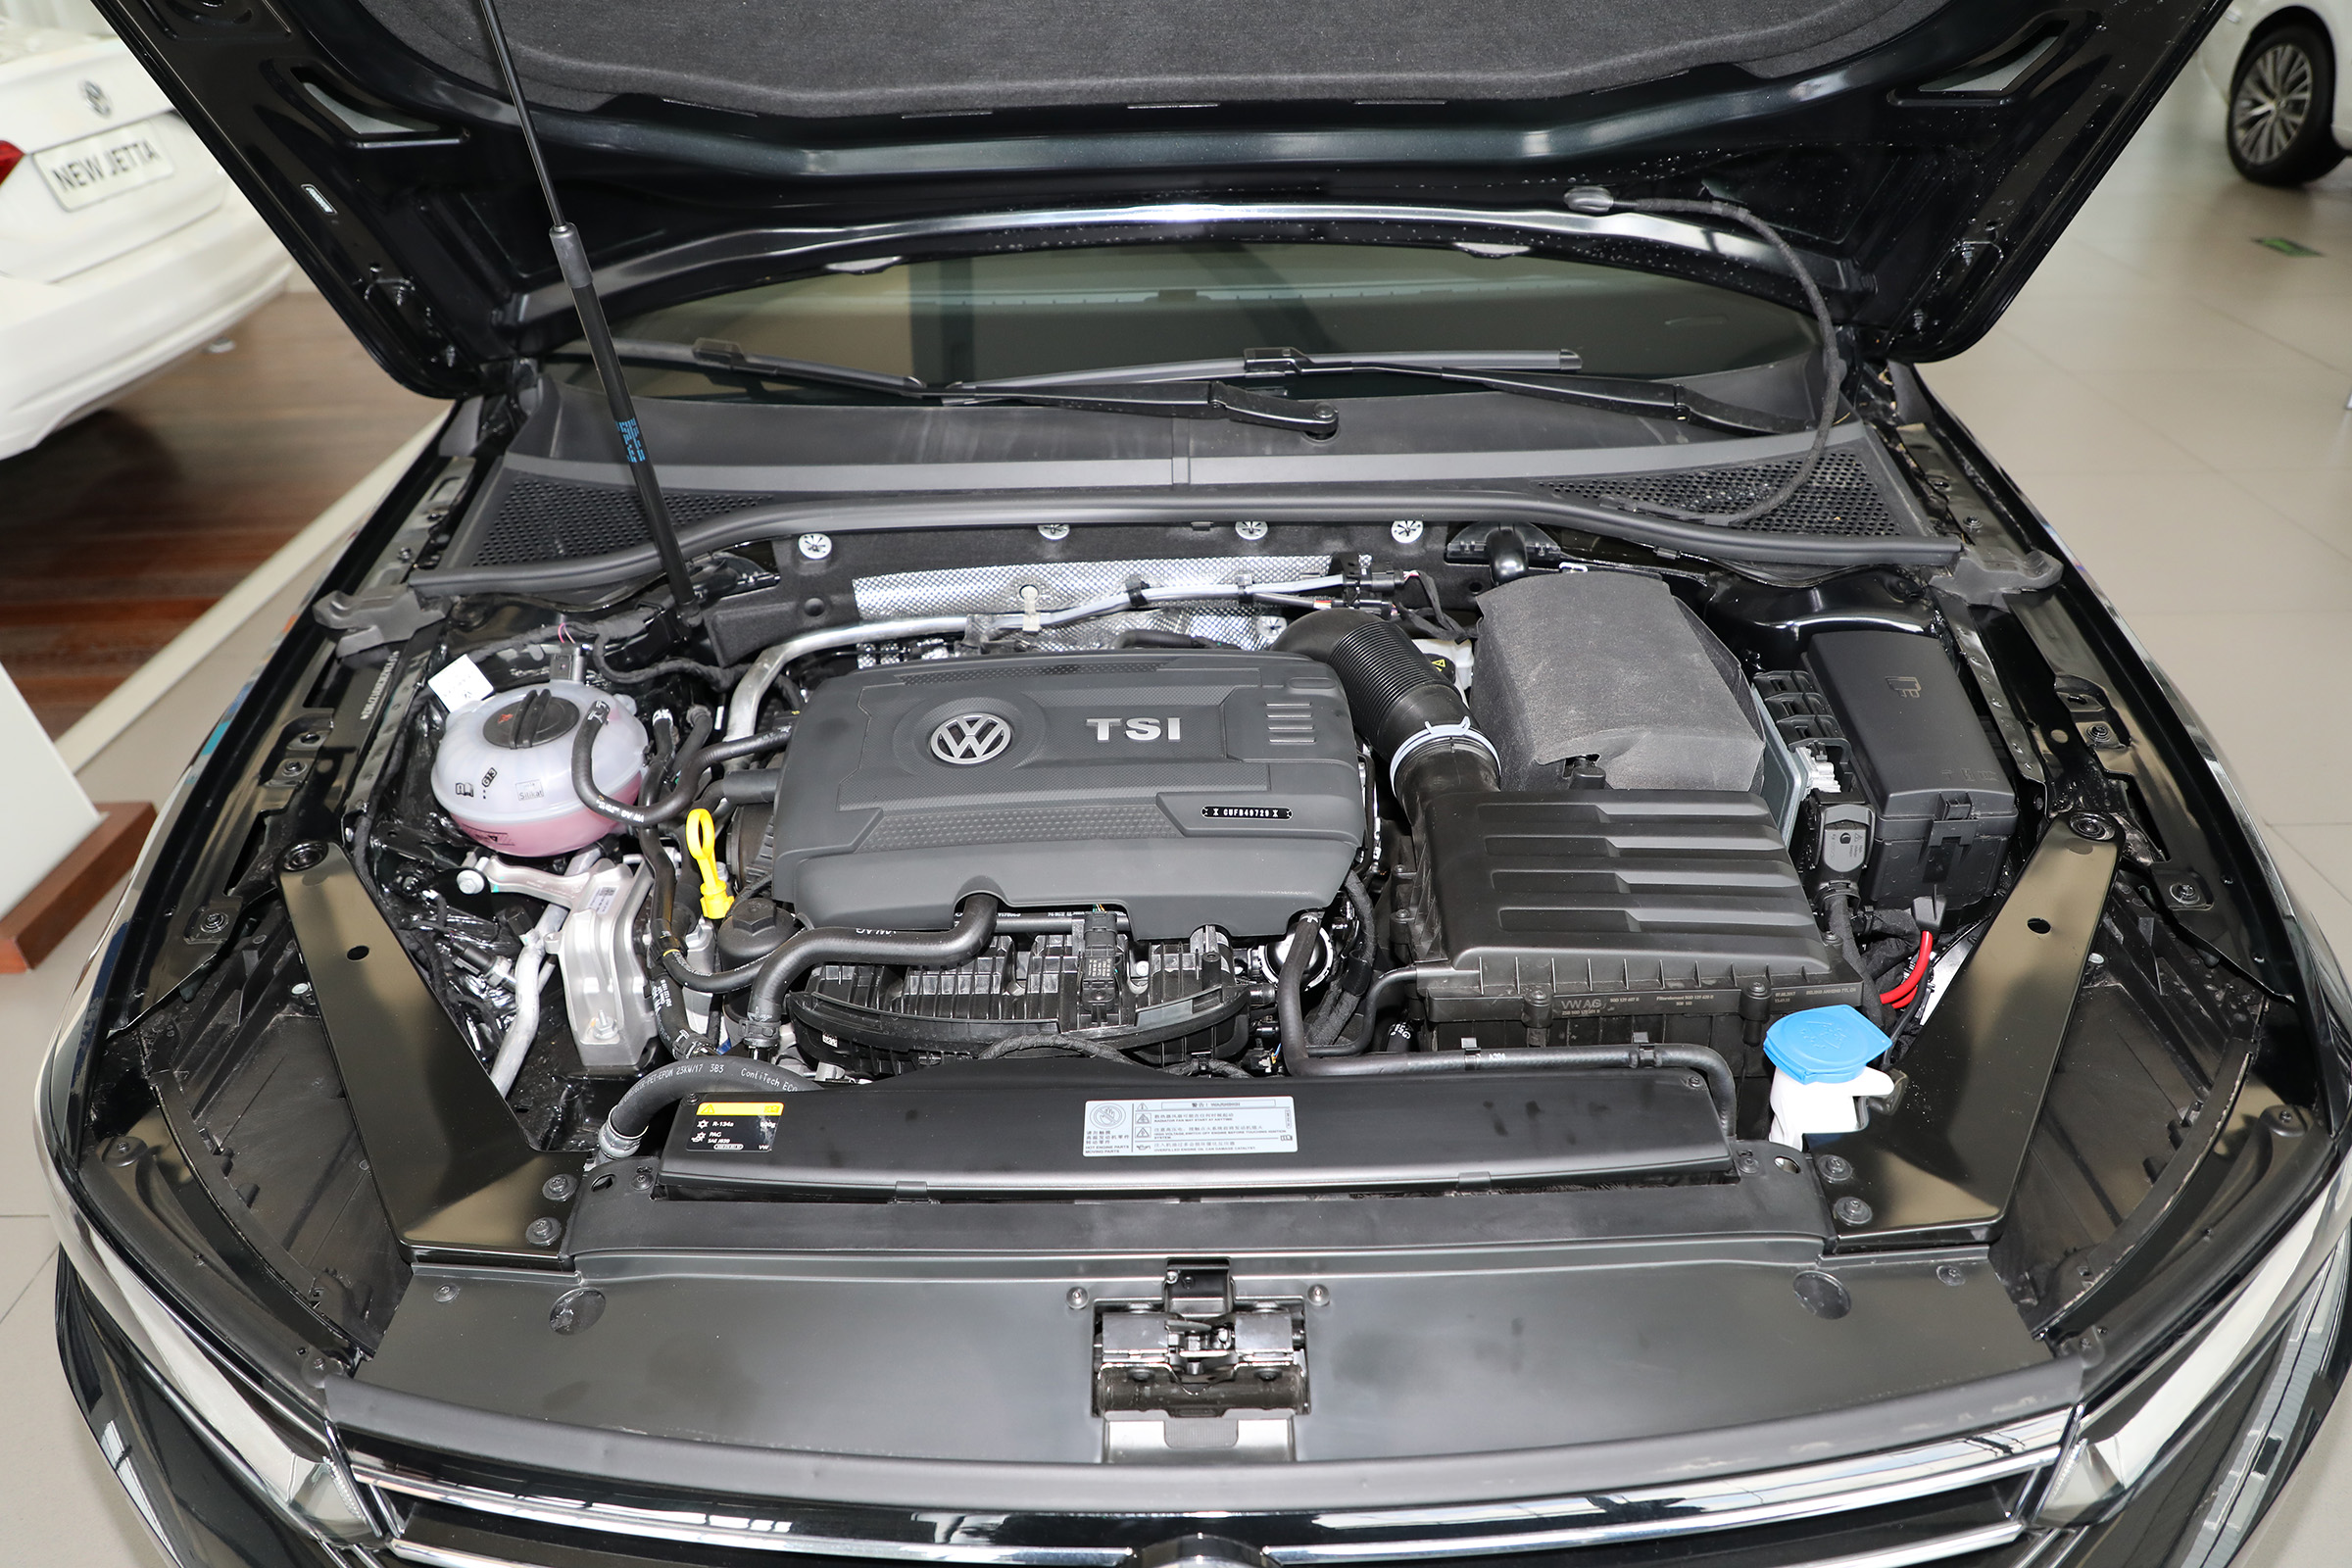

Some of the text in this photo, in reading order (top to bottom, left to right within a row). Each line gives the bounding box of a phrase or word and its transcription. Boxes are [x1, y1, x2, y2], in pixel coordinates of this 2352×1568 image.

[52, 139, 161, 192] NEW JETTA
[1086, 716, 1181, 741] TSI
[519, 790, 543, 800] Silikat
[1561, 999, 1602, 1009] VW AG
[740, 1067, 780, 1087] ContiTech
